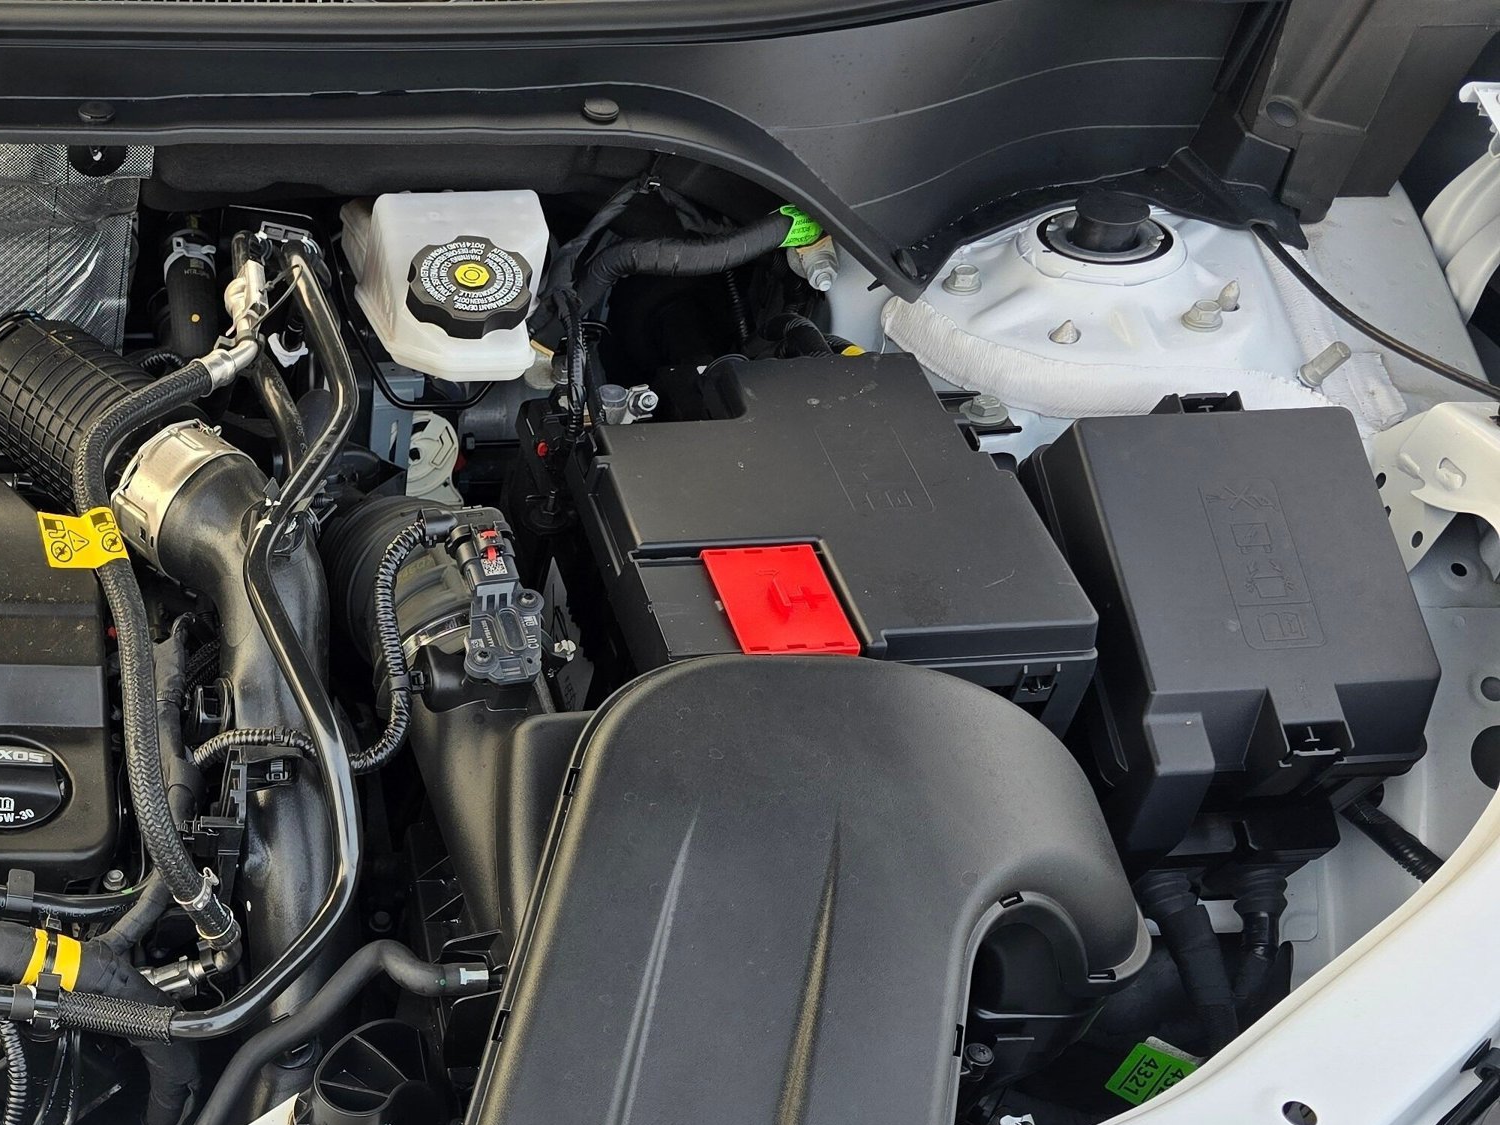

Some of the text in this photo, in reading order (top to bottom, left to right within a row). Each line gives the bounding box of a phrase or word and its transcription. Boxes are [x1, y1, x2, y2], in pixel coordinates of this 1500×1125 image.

[429, 245, 448, 258] FROM
[445, 241, 465, 249] FLUID
[421, 259, 432, 276] SEALED
[434, 284, 452, 297] ONLY
[440, 276, 456, 292] FILLER
[1123, 1058, 1159, 1095] 4321
